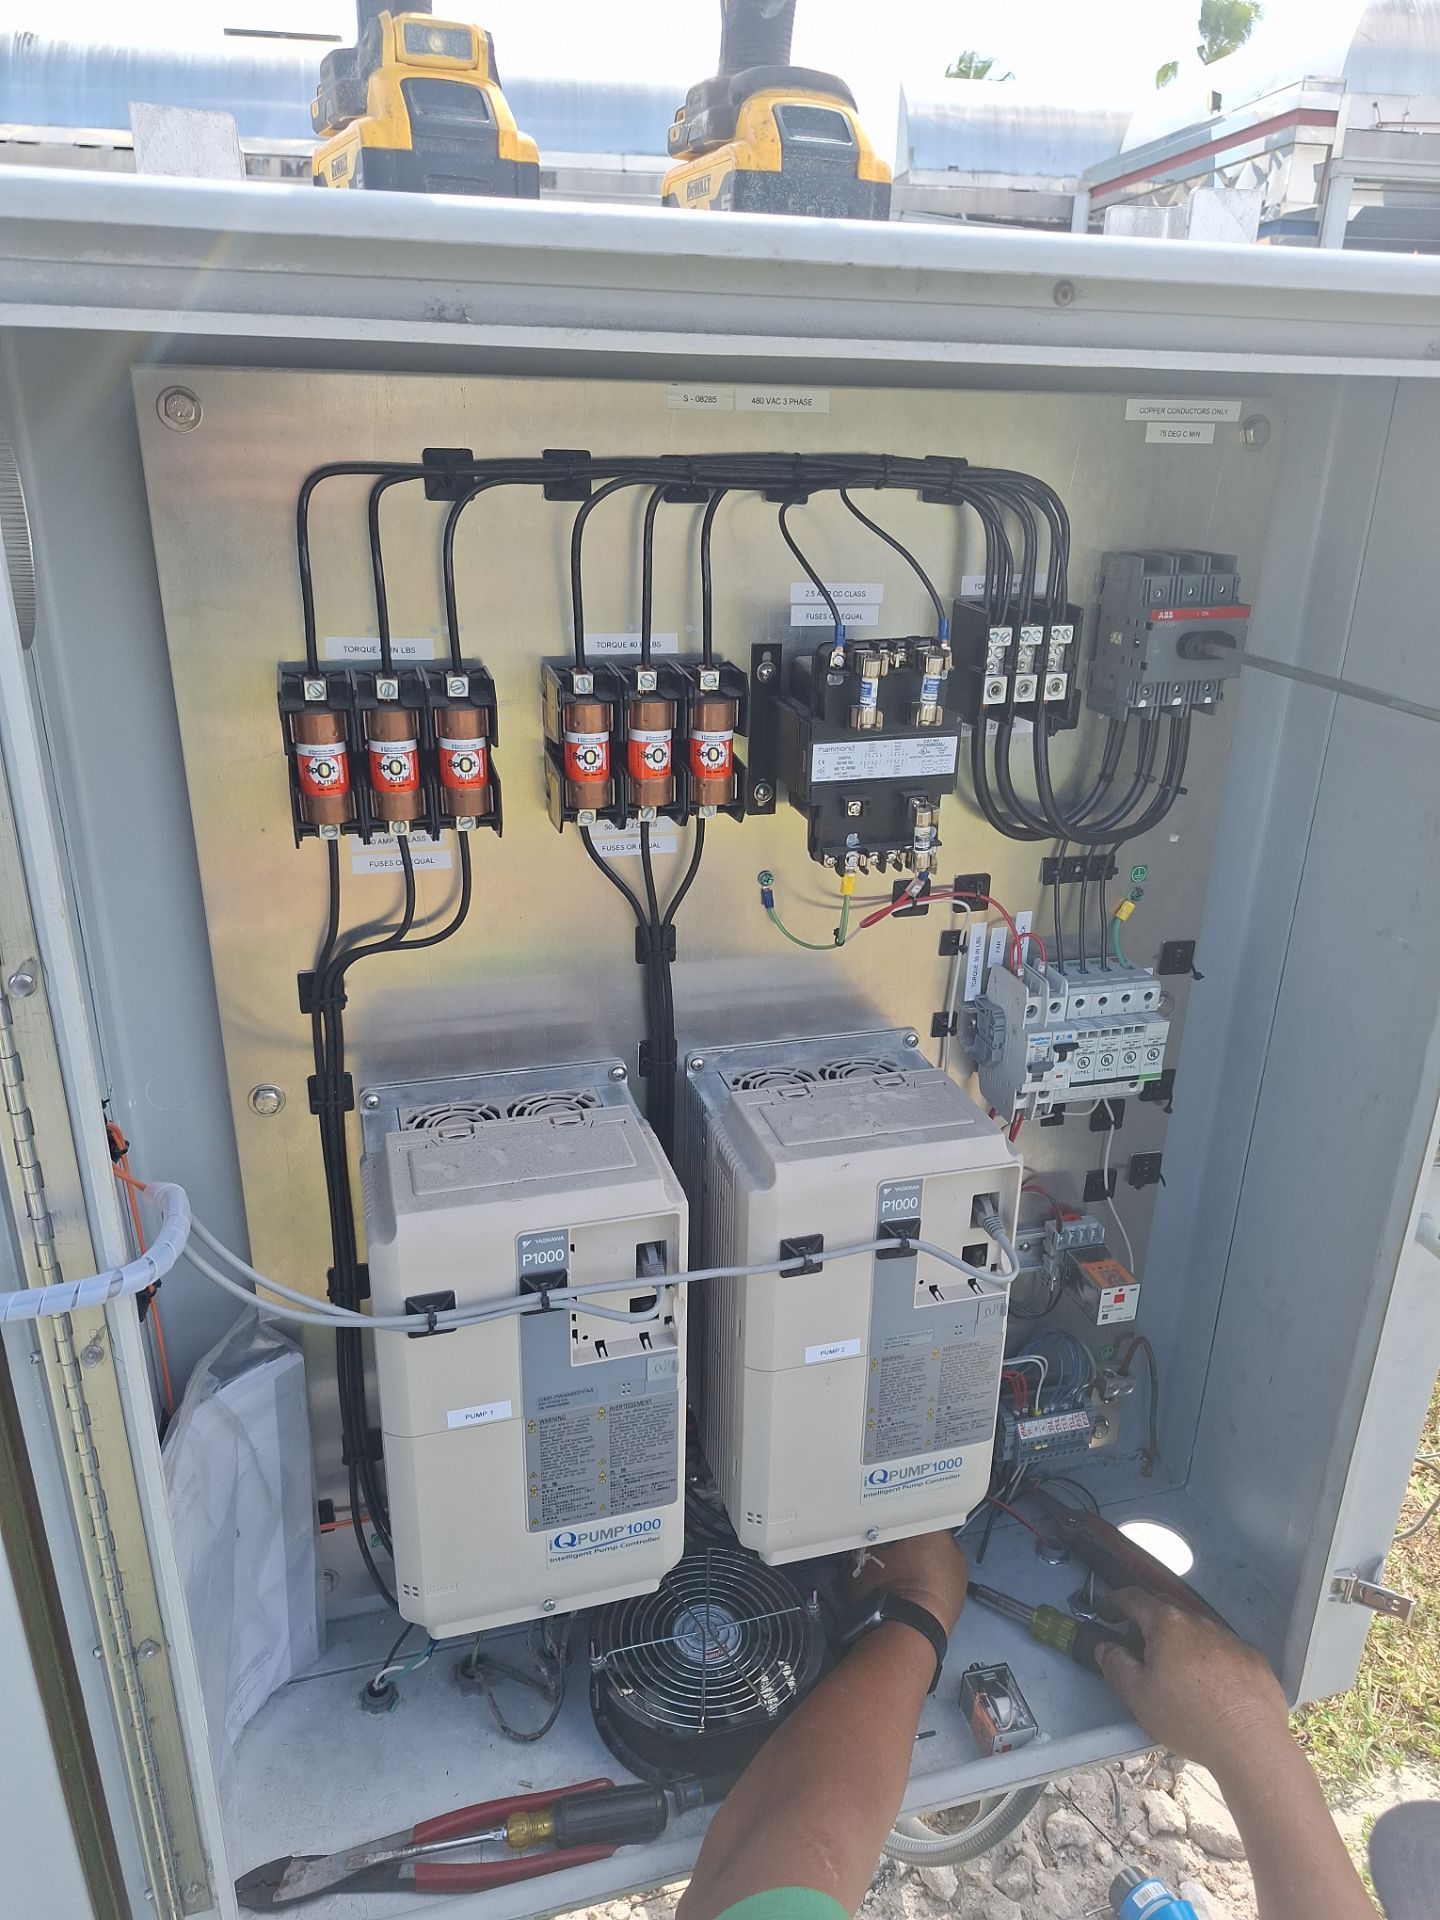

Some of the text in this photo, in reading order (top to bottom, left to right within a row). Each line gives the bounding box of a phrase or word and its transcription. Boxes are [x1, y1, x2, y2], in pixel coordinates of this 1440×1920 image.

[751, 396, 765, 405] 480
[765, 397, 782, 406] VAC
[788, 398, 813, 407] PHASE
[1139, 407, 1166, 415] COPPER
[1166, 407, 1210, 415] CONDUCTORS
[1168, 430, 1182, 438] DEG
[805, 590, 816, 598] 2.5
[832, 590, 843, 598] CC
[844, 590, 867, 598] CLASS
[1158, 611, 1174, 619] ABB
[596, 641, 628, 649] TORQUE
[343, 645, 377, 654] TORQUE
[401, 646, 416, 654] LBS
[818, 745, 856, 753] hammond
[601, 844, 626, 852] FUSES
[369, 860, 394, 868] FUSES
[971, 964, 979, 988] TORQUE
[882, 1196, 918, 1213] P1000
[522, 1248, 565, 1267] P1000
[820, 1348, 840, 1356] PUMP
[465, 1410, 488, 1420] PUMP
[863, 1473, 961, 1499] Intelligent Pump Controller
[549, 1536, 661, 1563] Intelligent Pump Controller
